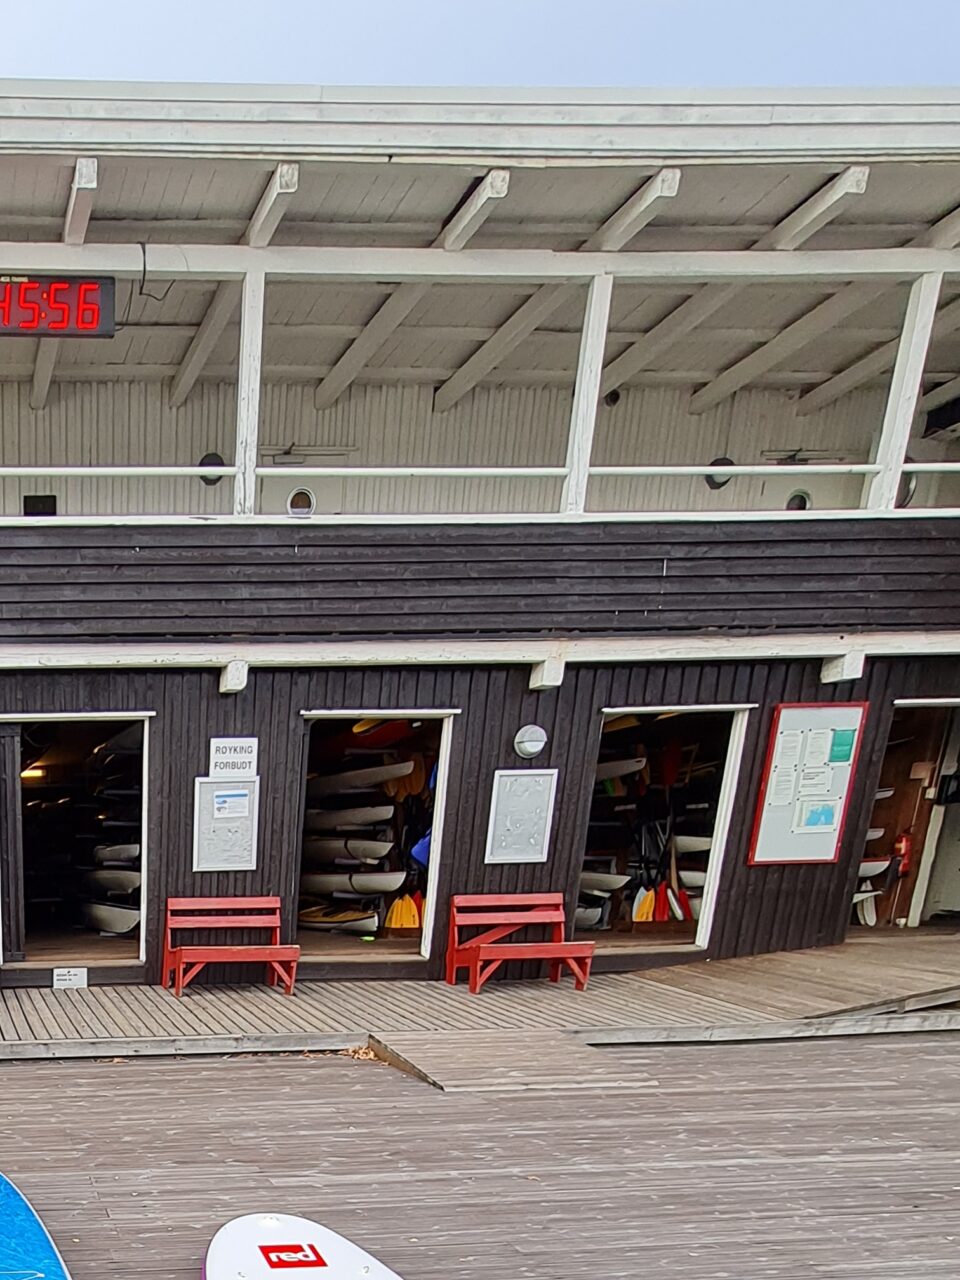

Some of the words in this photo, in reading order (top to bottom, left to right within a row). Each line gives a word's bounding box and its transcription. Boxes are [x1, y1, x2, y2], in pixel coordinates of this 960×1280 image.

[214, 745, 254, 755] RØYKING
[213, 761, 253, 770] FORBUDT
[268, 1244, 318, 1263] red
